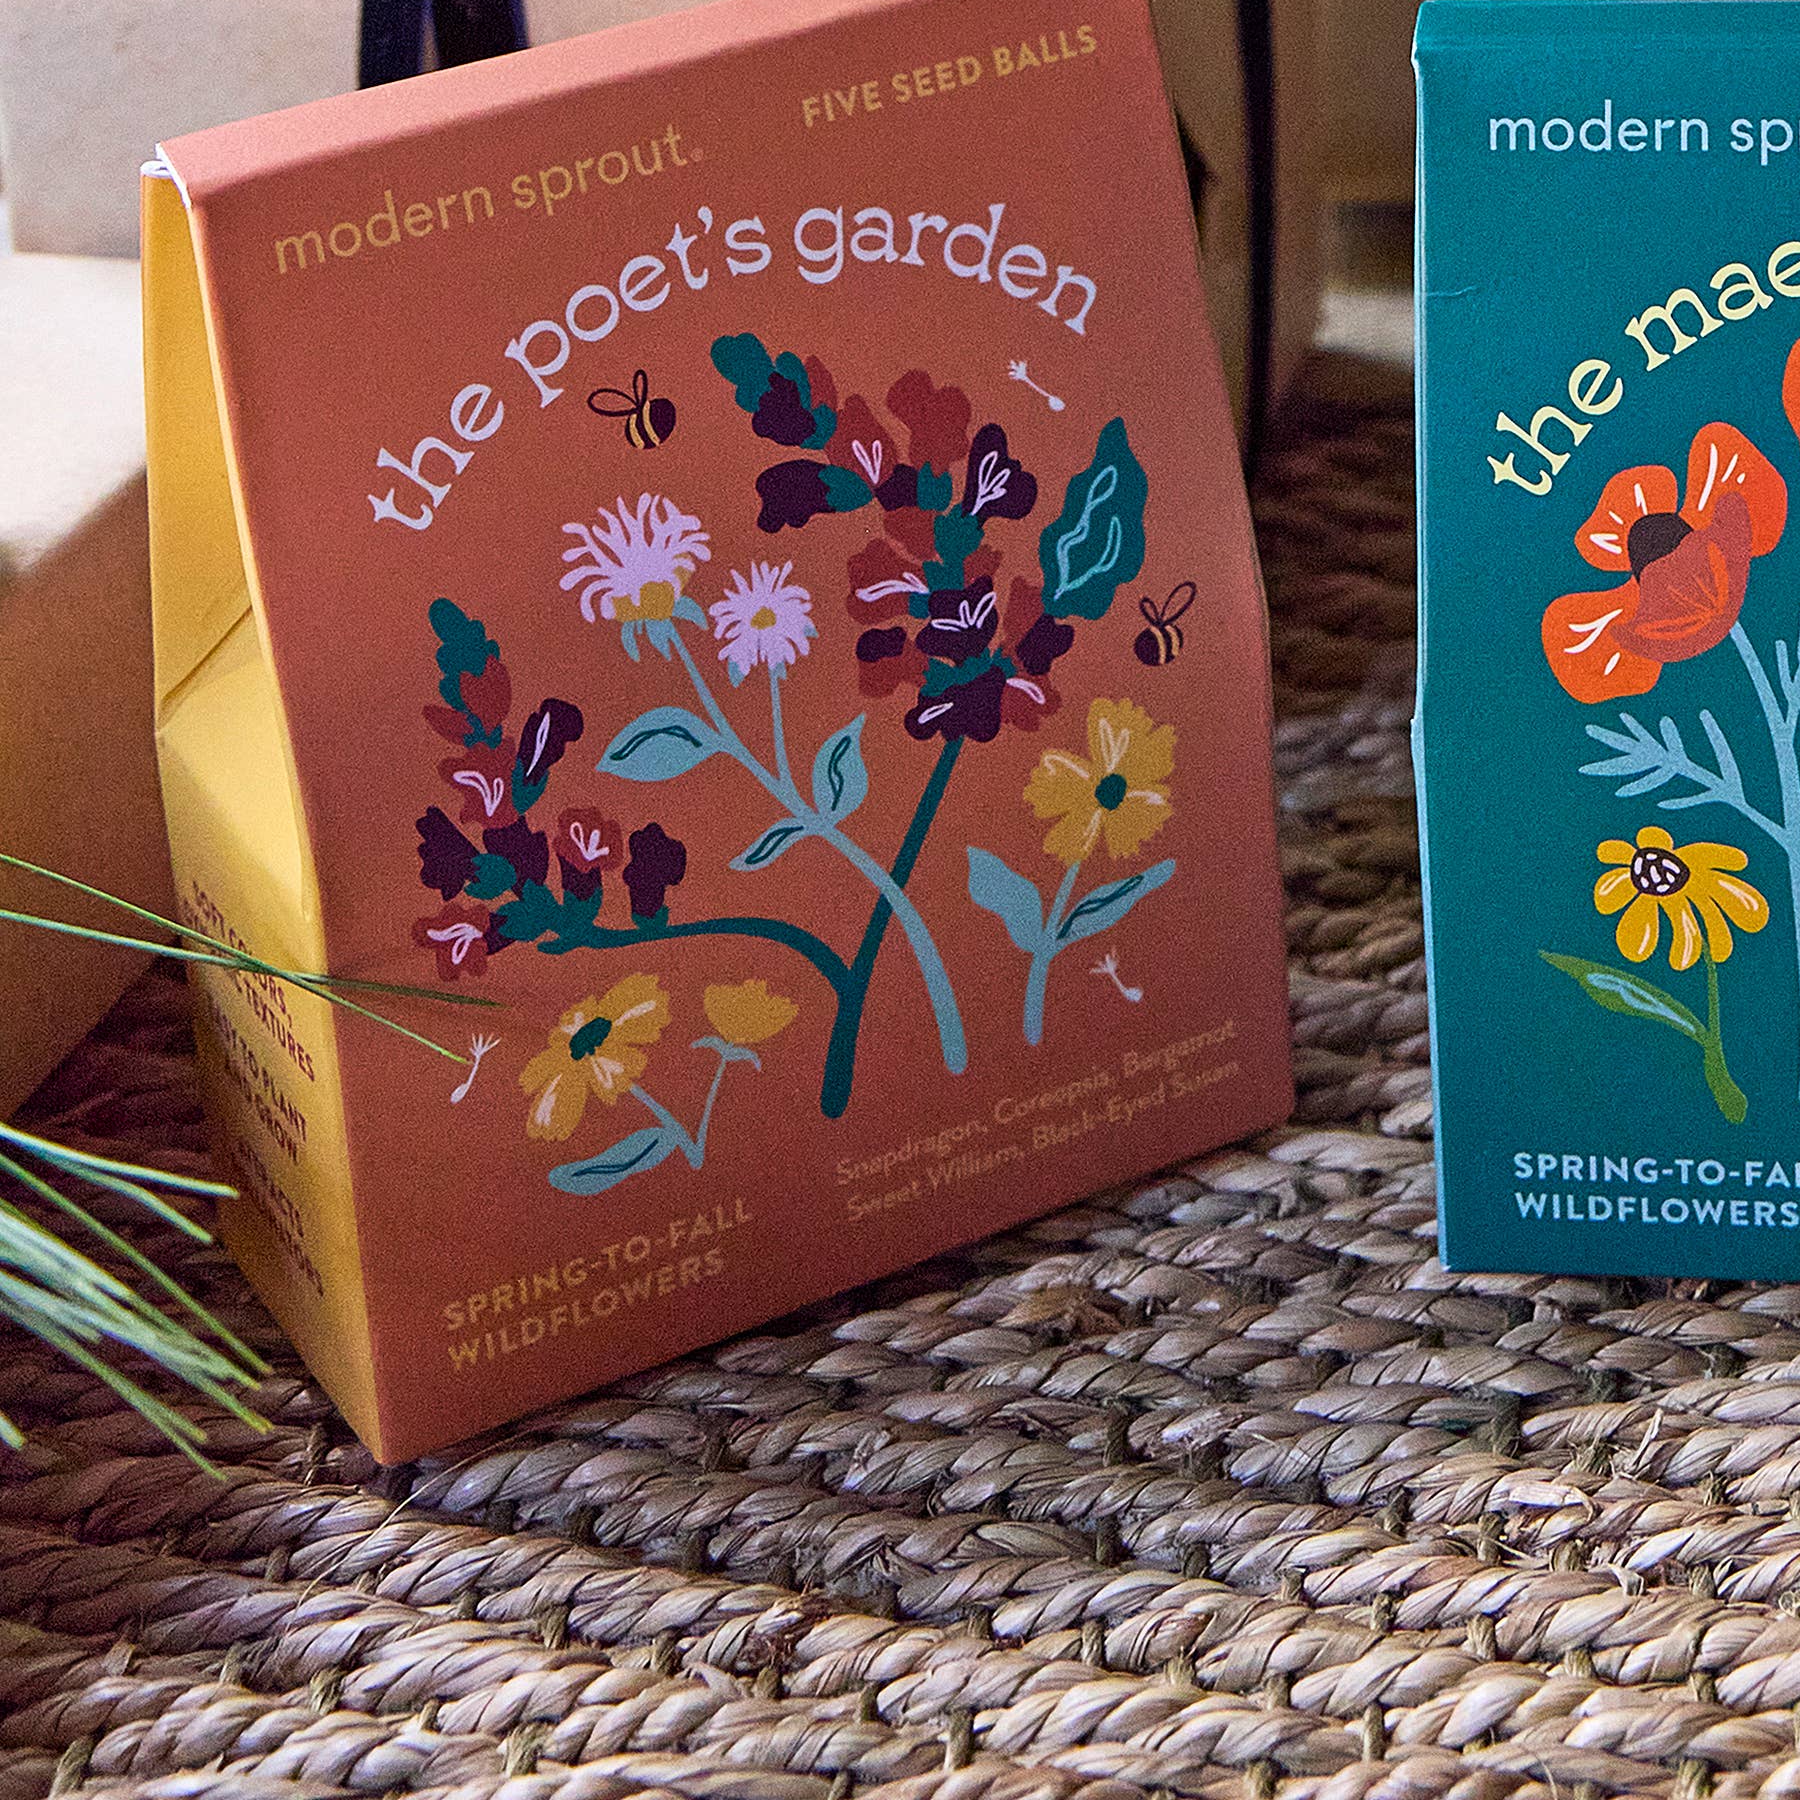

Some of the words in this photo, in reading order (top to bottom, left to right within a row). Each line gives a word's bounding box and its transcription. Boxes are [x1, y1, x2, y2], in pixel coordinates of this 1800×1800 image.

[802, 81, 882, 127] FIVE
[893, 57, 981, 101] SEED
[993, 26, 1096, 76] BALLS
[1490, 99, 1708, 151] modern
[275, 187, 494, 274] modern
[368, 384, 503, 530] the
[794, 204, 1096, 335] garden
[1488, 360, 1623, 495] the
[244, 977, 315, 1081] TEXTURES
[254, 1093, 298, 1166] GROW
[262, 1065, 307, 1142] PLANT
[1515, 1192, 1799, 1227] WILDFLOWERS
[444, 1200, 749, 1330] SPRING-TO-FALL
[448, 1250, 728, 1370] WILDFLOWERS
